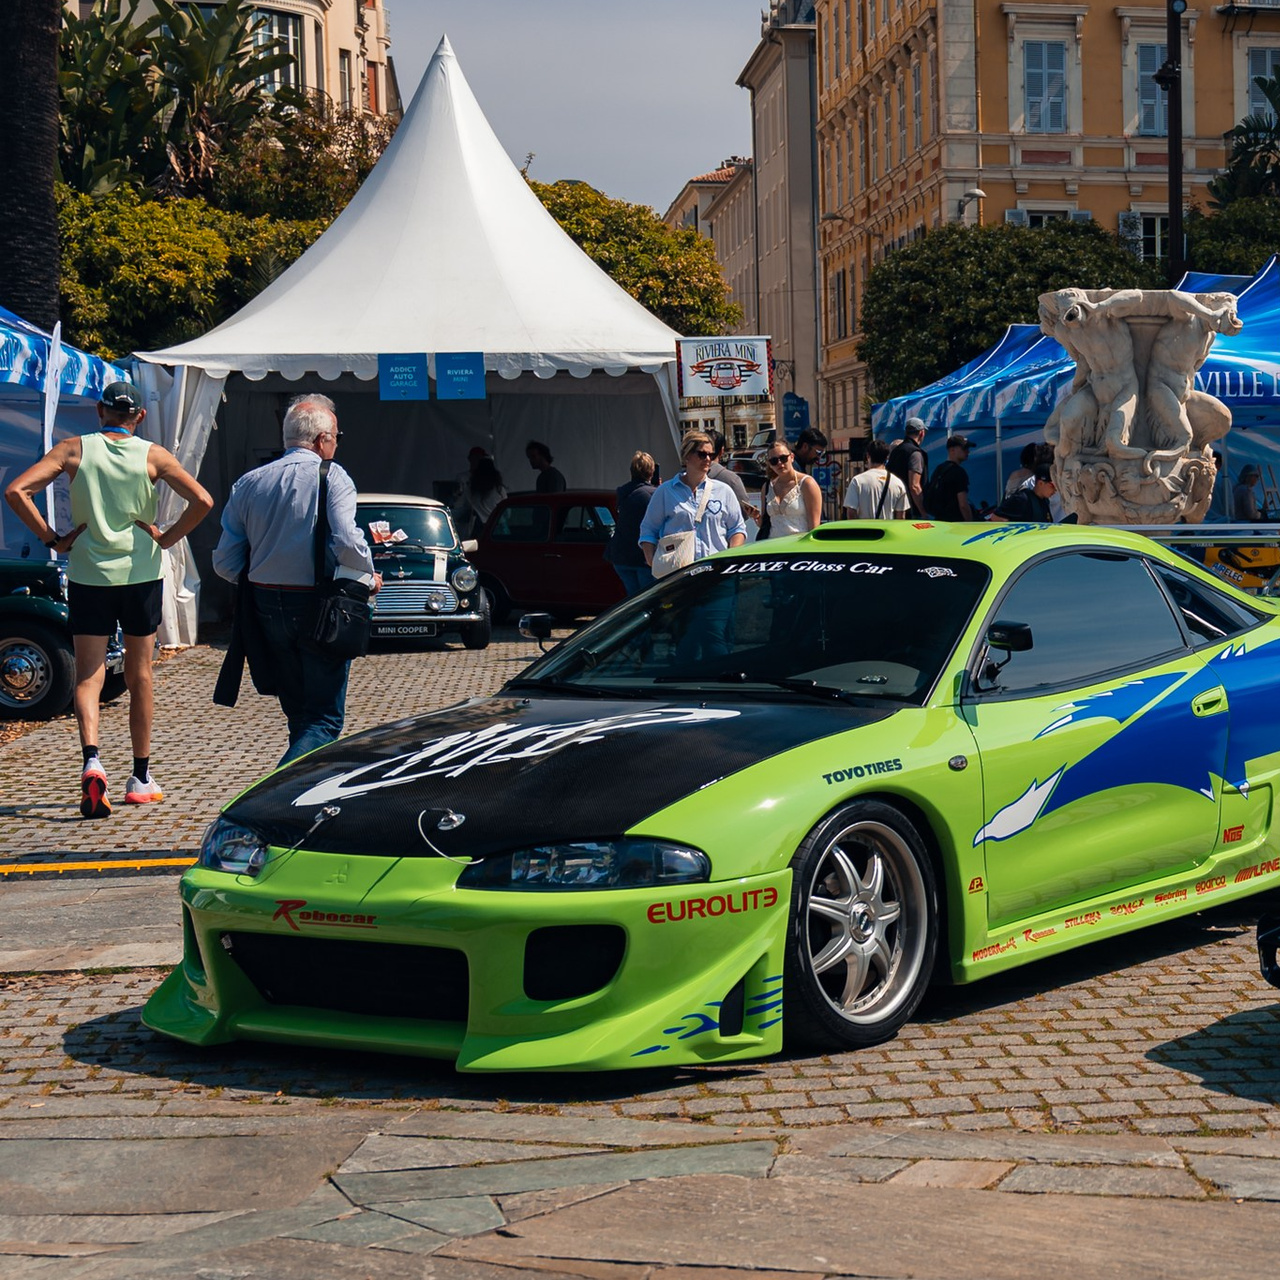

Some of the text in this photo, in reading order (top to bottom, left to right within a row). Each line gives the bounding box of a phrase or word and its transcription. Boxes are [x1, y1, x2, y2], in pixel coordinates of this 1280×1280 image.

[695, 343, 757, 362] RIVIERA MINI
[1195, 371, 1264, 398] VILLE
[721, 561, 788, 575] LUXE
[790, 560, 846, 573] Gloss
[850, 562, 893, 575] Car
[397, 626, 429, 634] COOPER
[822, 758, 903, 785] TOYO TIRES
